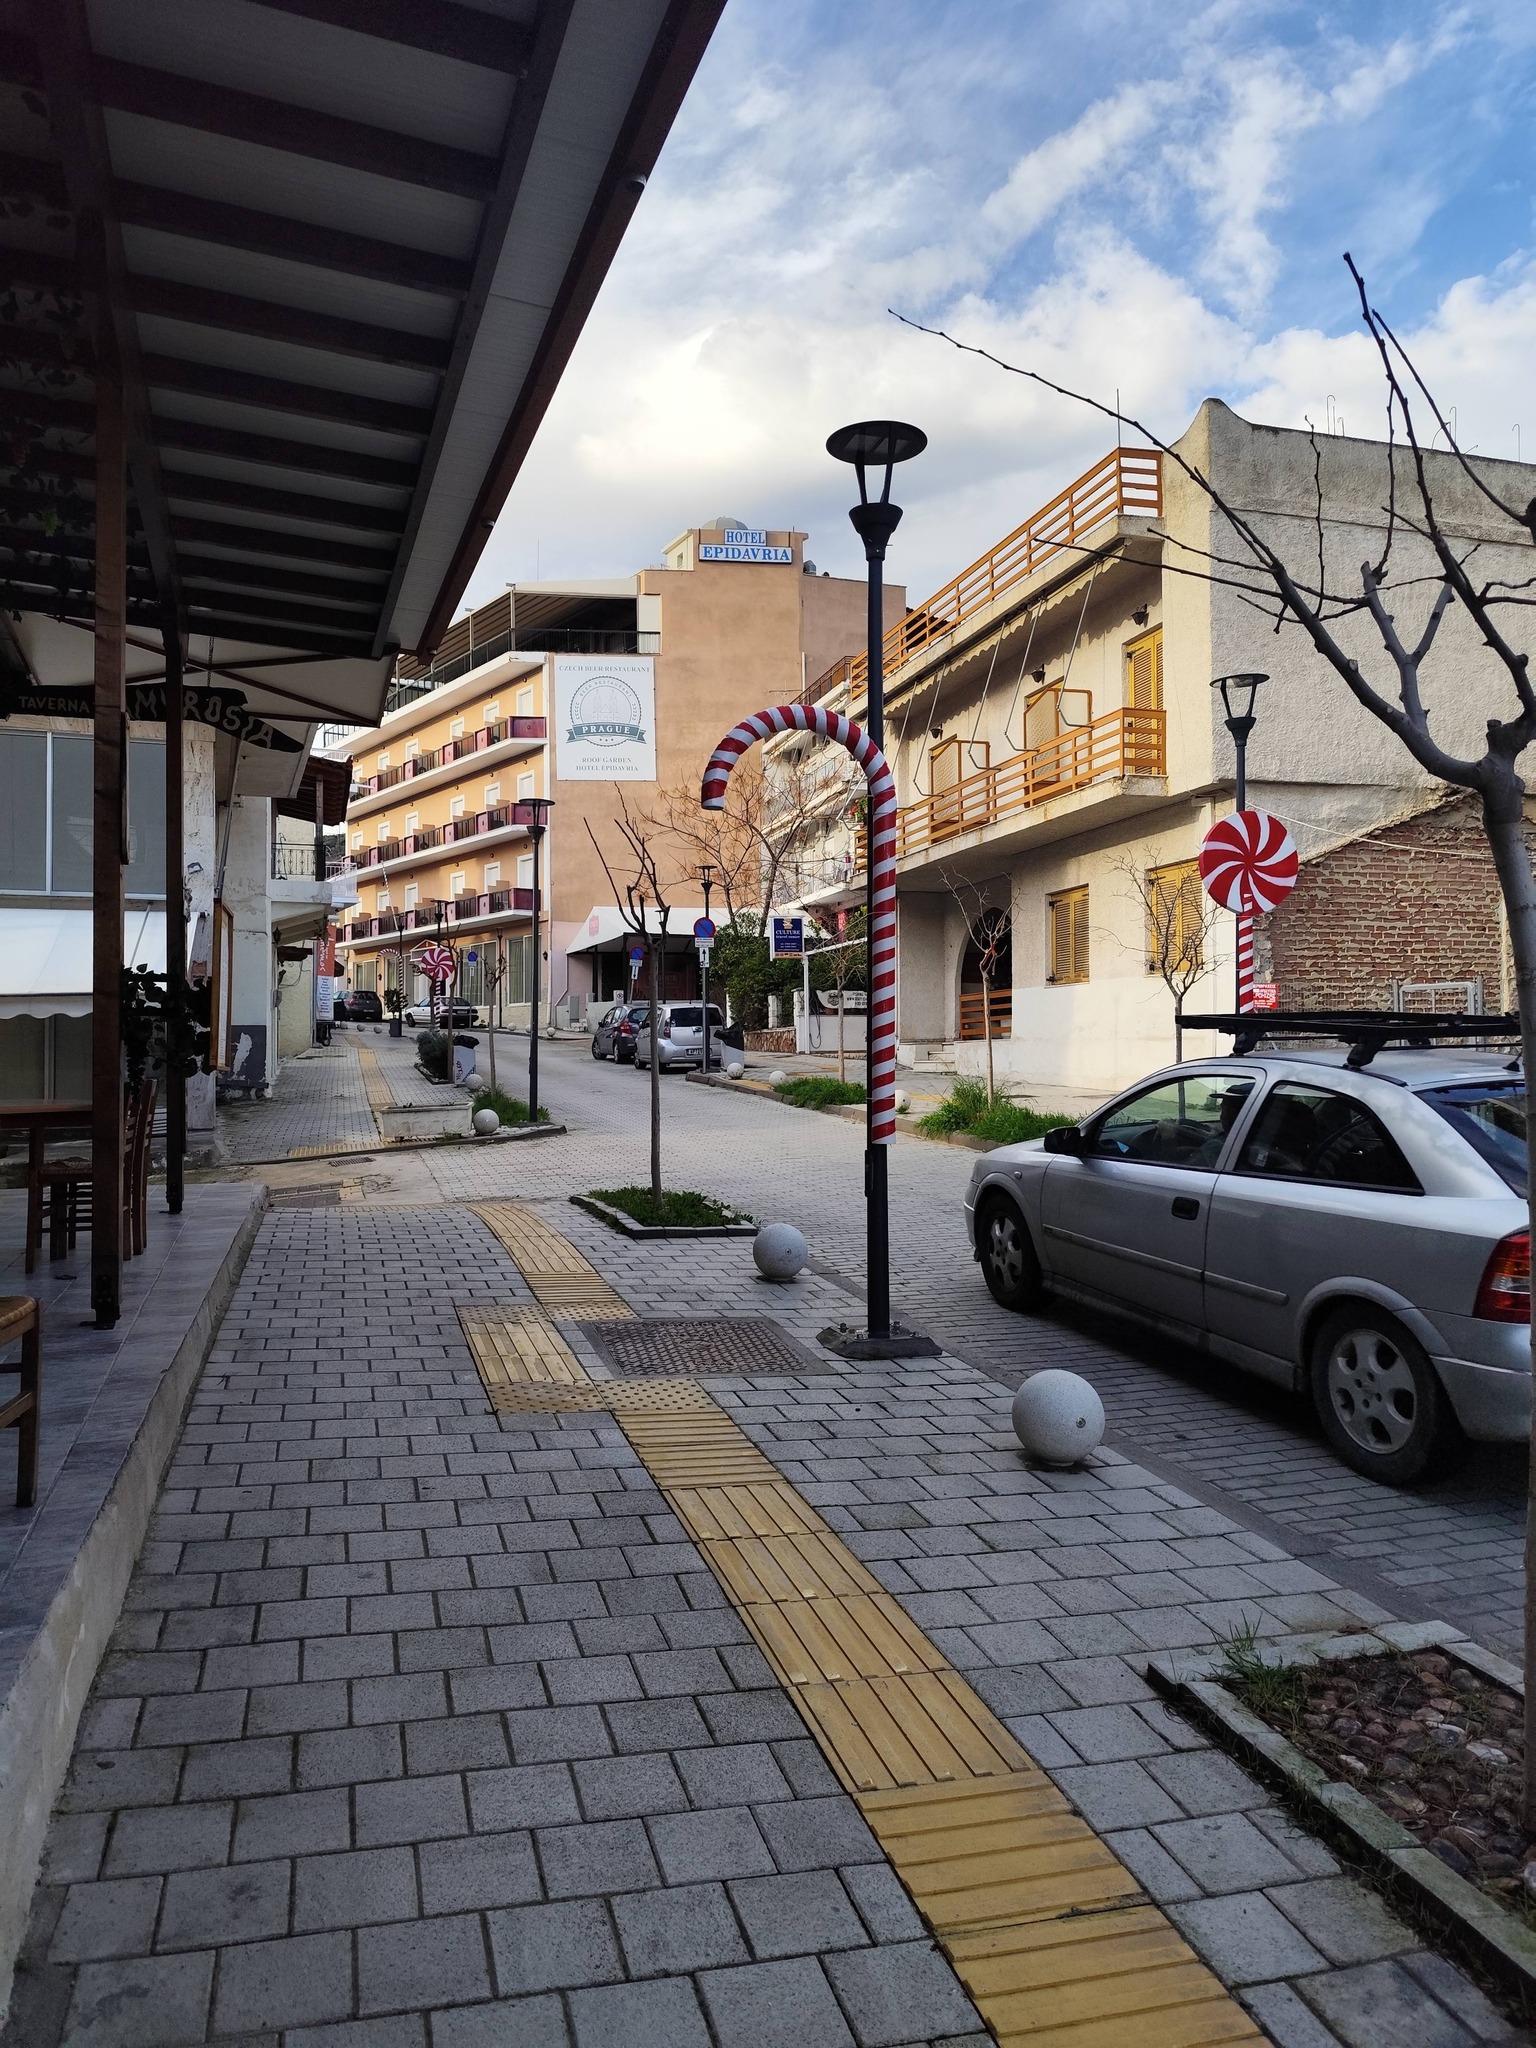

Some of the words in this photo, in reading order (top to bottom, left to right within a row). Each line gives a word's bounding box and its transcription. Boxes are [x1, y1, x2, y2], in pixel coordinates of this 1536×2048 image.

[726, 531, 765, 544] HOTEL
[703, 546, 790, 561] EPIDAVRIA
[579, 684, 593, 697] BEER
[594, 680, 633, 698] RESTAURANT
[18, 695, 91, 714] TAVERNA
[126, 688, 274, 749] MROSIA
[582, 725, 631, 734] PRAGUE
